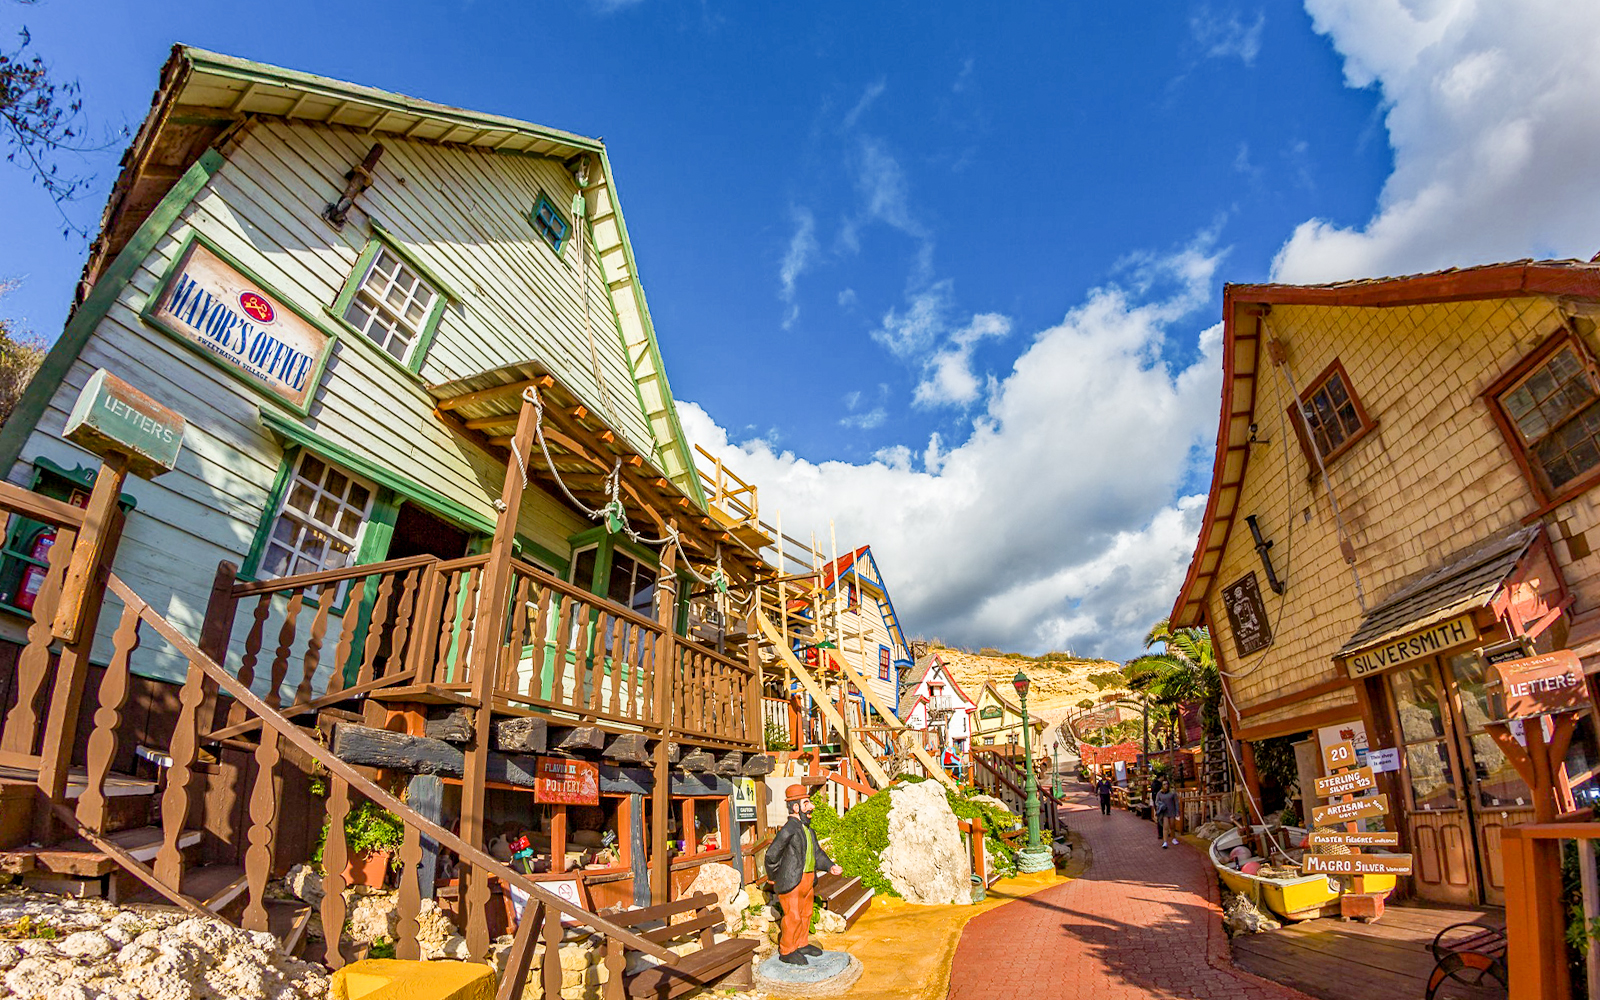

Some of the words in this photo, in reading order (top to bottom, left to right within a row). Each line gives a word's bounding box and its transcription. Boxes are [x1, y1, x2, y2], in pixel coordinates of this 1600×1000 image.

[164, 272, 254, 355] MAYOR'S
[249, 331, 313, 392] OFFICE
[197, 336, 241, 366] SWEETHAVEN
[242, 362, 268, 382] VILLAGE
[104, 395, 174, 443] LETTERS
[1353, 620, 1467, 674] SILVERSMITH
[1510, 672, 1576, 697] LETTERS
[1331, 746, 1348, 762] 20
[545, 778, 580, 794] POTTERY
[1319, 772, 1360, 789] STERLING
[1329, 783, 1354, 794] SILVER
[1356, 777, 1371, 788] 925
[1327, 801, 1364, 815] ARTISAN
[1307, 856, 1351, 871] MAGRO
[1355, 861, 1385, 872] SILVER
